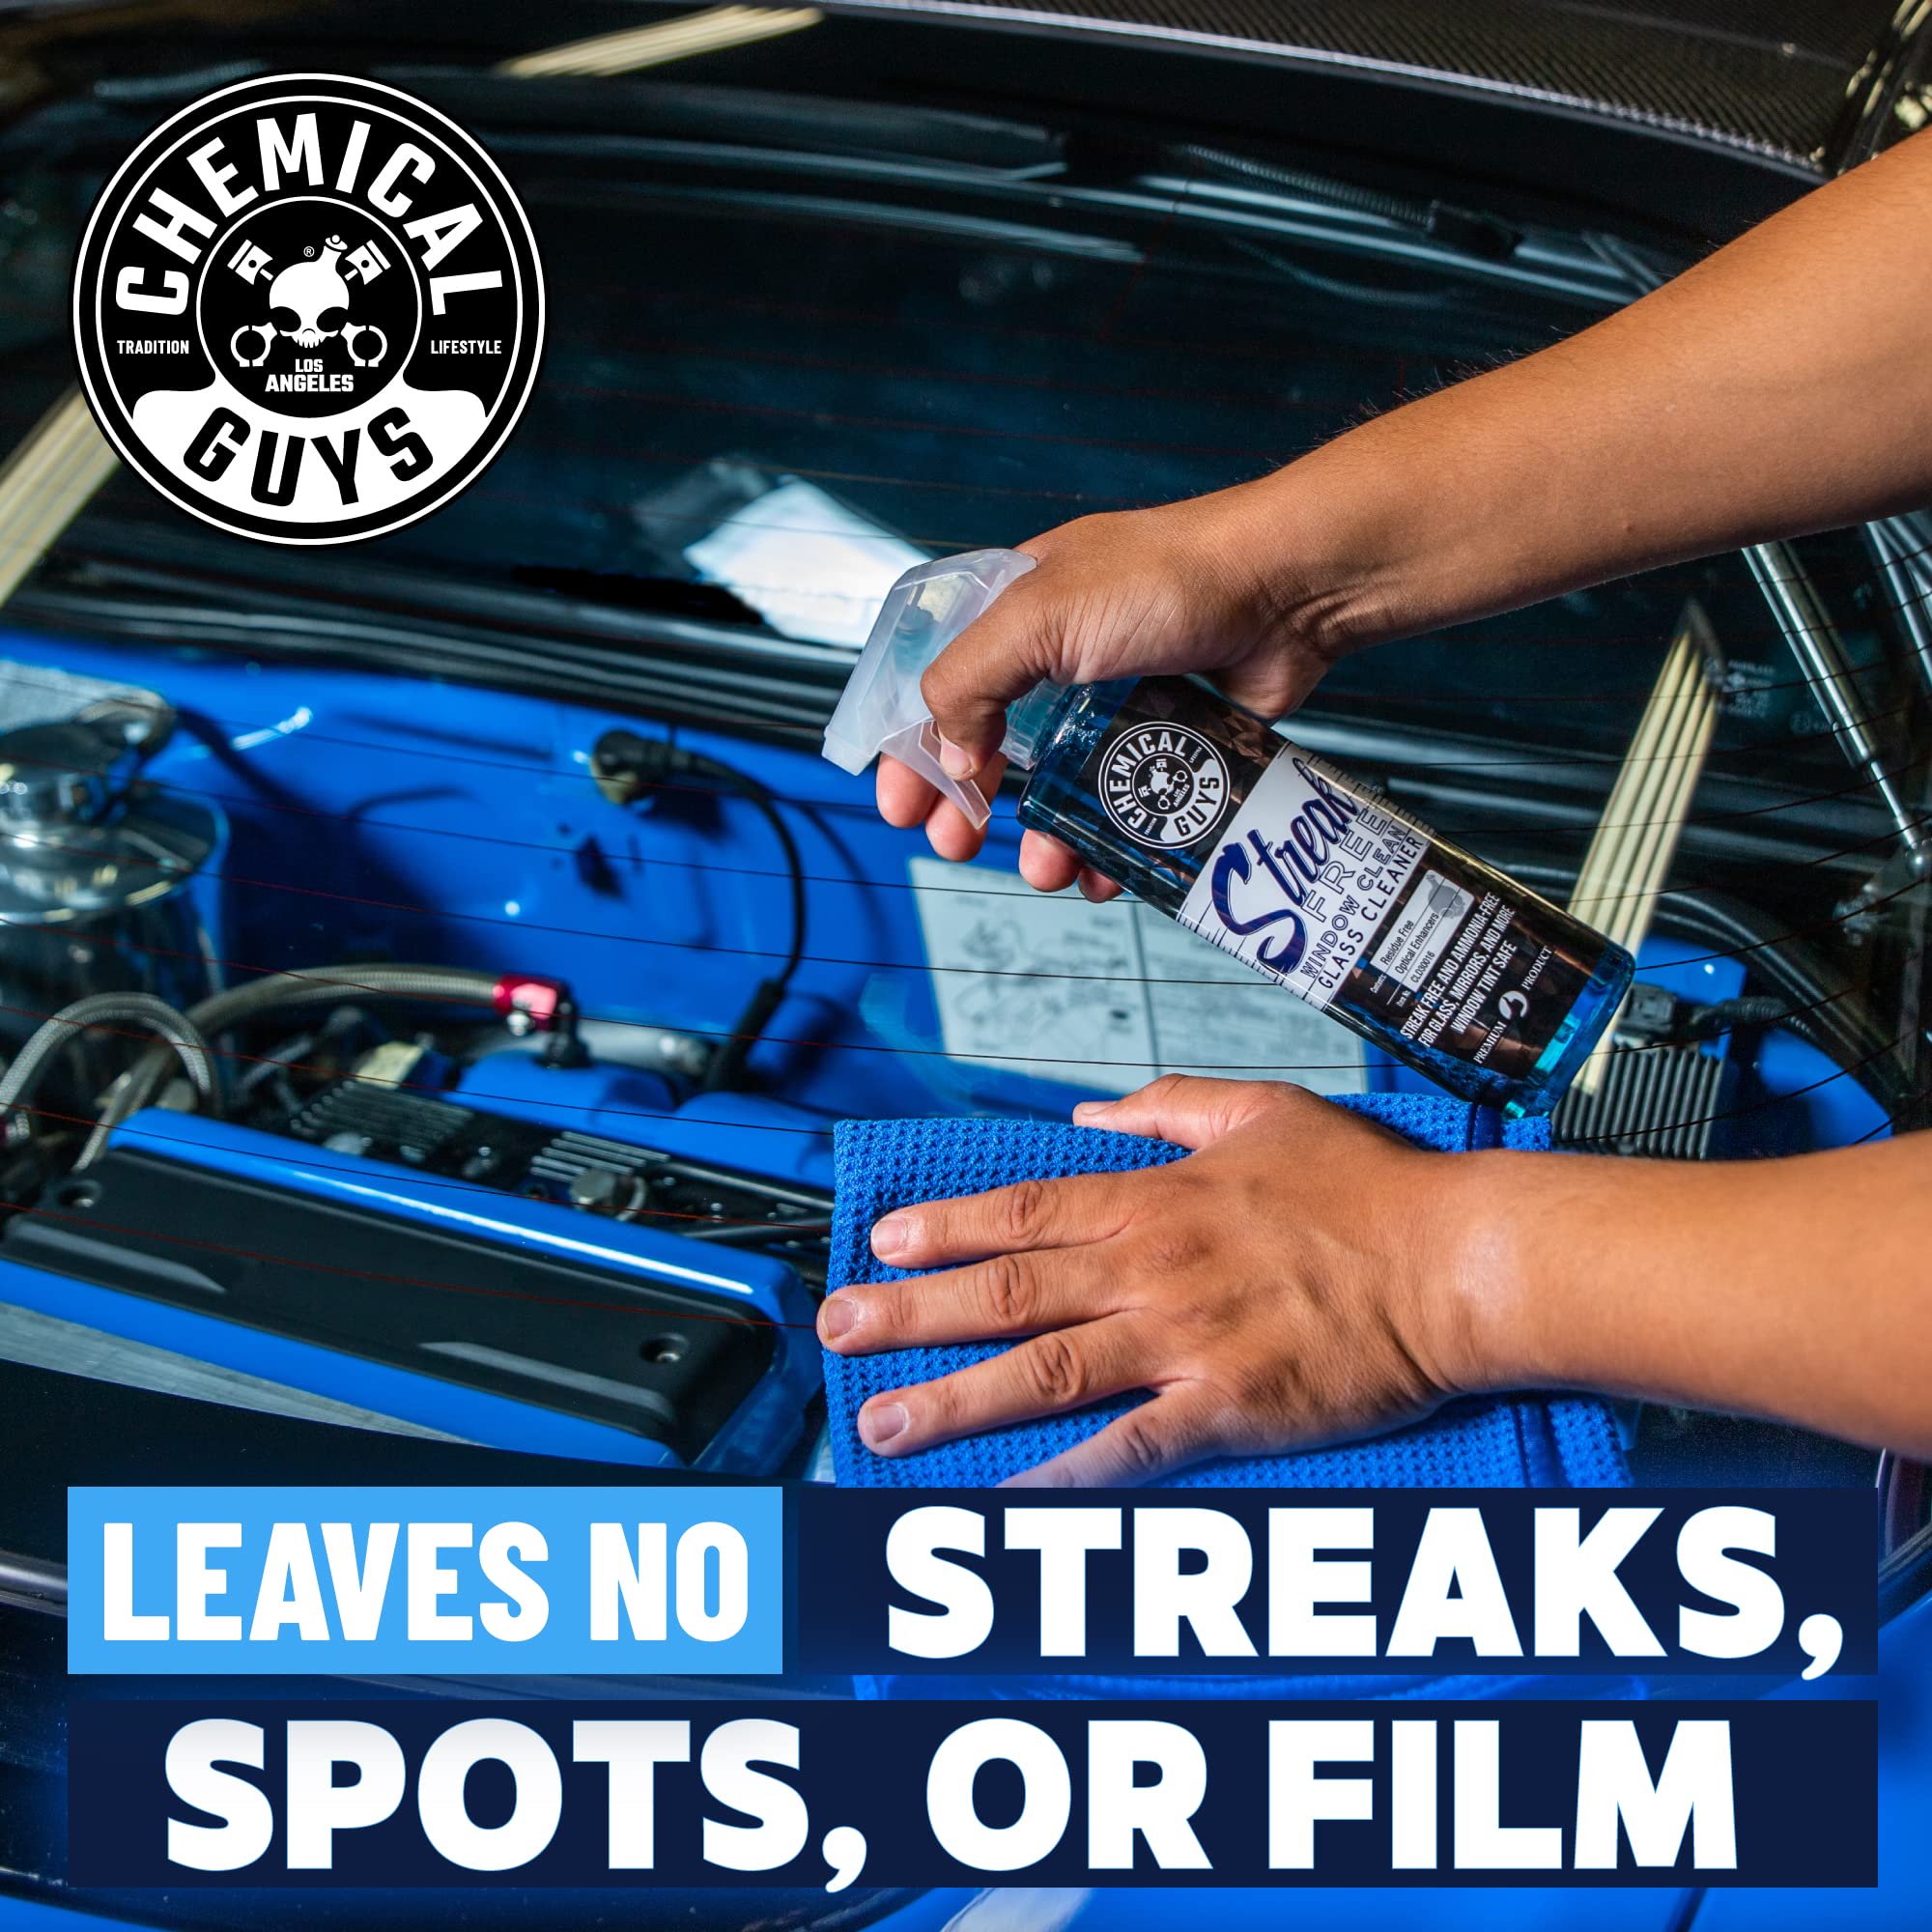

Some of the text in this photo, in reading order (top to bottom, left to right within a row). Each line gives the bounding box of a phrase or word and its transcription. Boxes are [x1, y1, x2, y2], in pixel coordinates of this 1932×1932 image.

[1109, 731, 1187, 829] CHEMICAL
[1173, 783, 1190, 808] ANGELES
[1173, 777, 1220, 838] GUYS
[1211, 757, 1360, 975] Streak
[1300, 808, 1388, 923] FREE
[1300, 825, 1406, 979] WINDOW CLEAN
[1318, 838, 1424, 989] GLASS CLEANER
[1380, 920, 1414, 965] Residue Free
[1394, 912, 1439, 976] Optical Enhancers
[1400, 892, 1500, 1039] STREAK FREE AND AMMONIA-FREE
[1410, 951, 1435, 983] CLD30016
[1418, 904, 1516, 1048] FOR GLASS, MIRRORS, AND MORE
[1451, 940, 1518, 1035] WINDOW TINT SAFE
[1473, 945, 1552, 1065] PREMIUM PRODUCT
